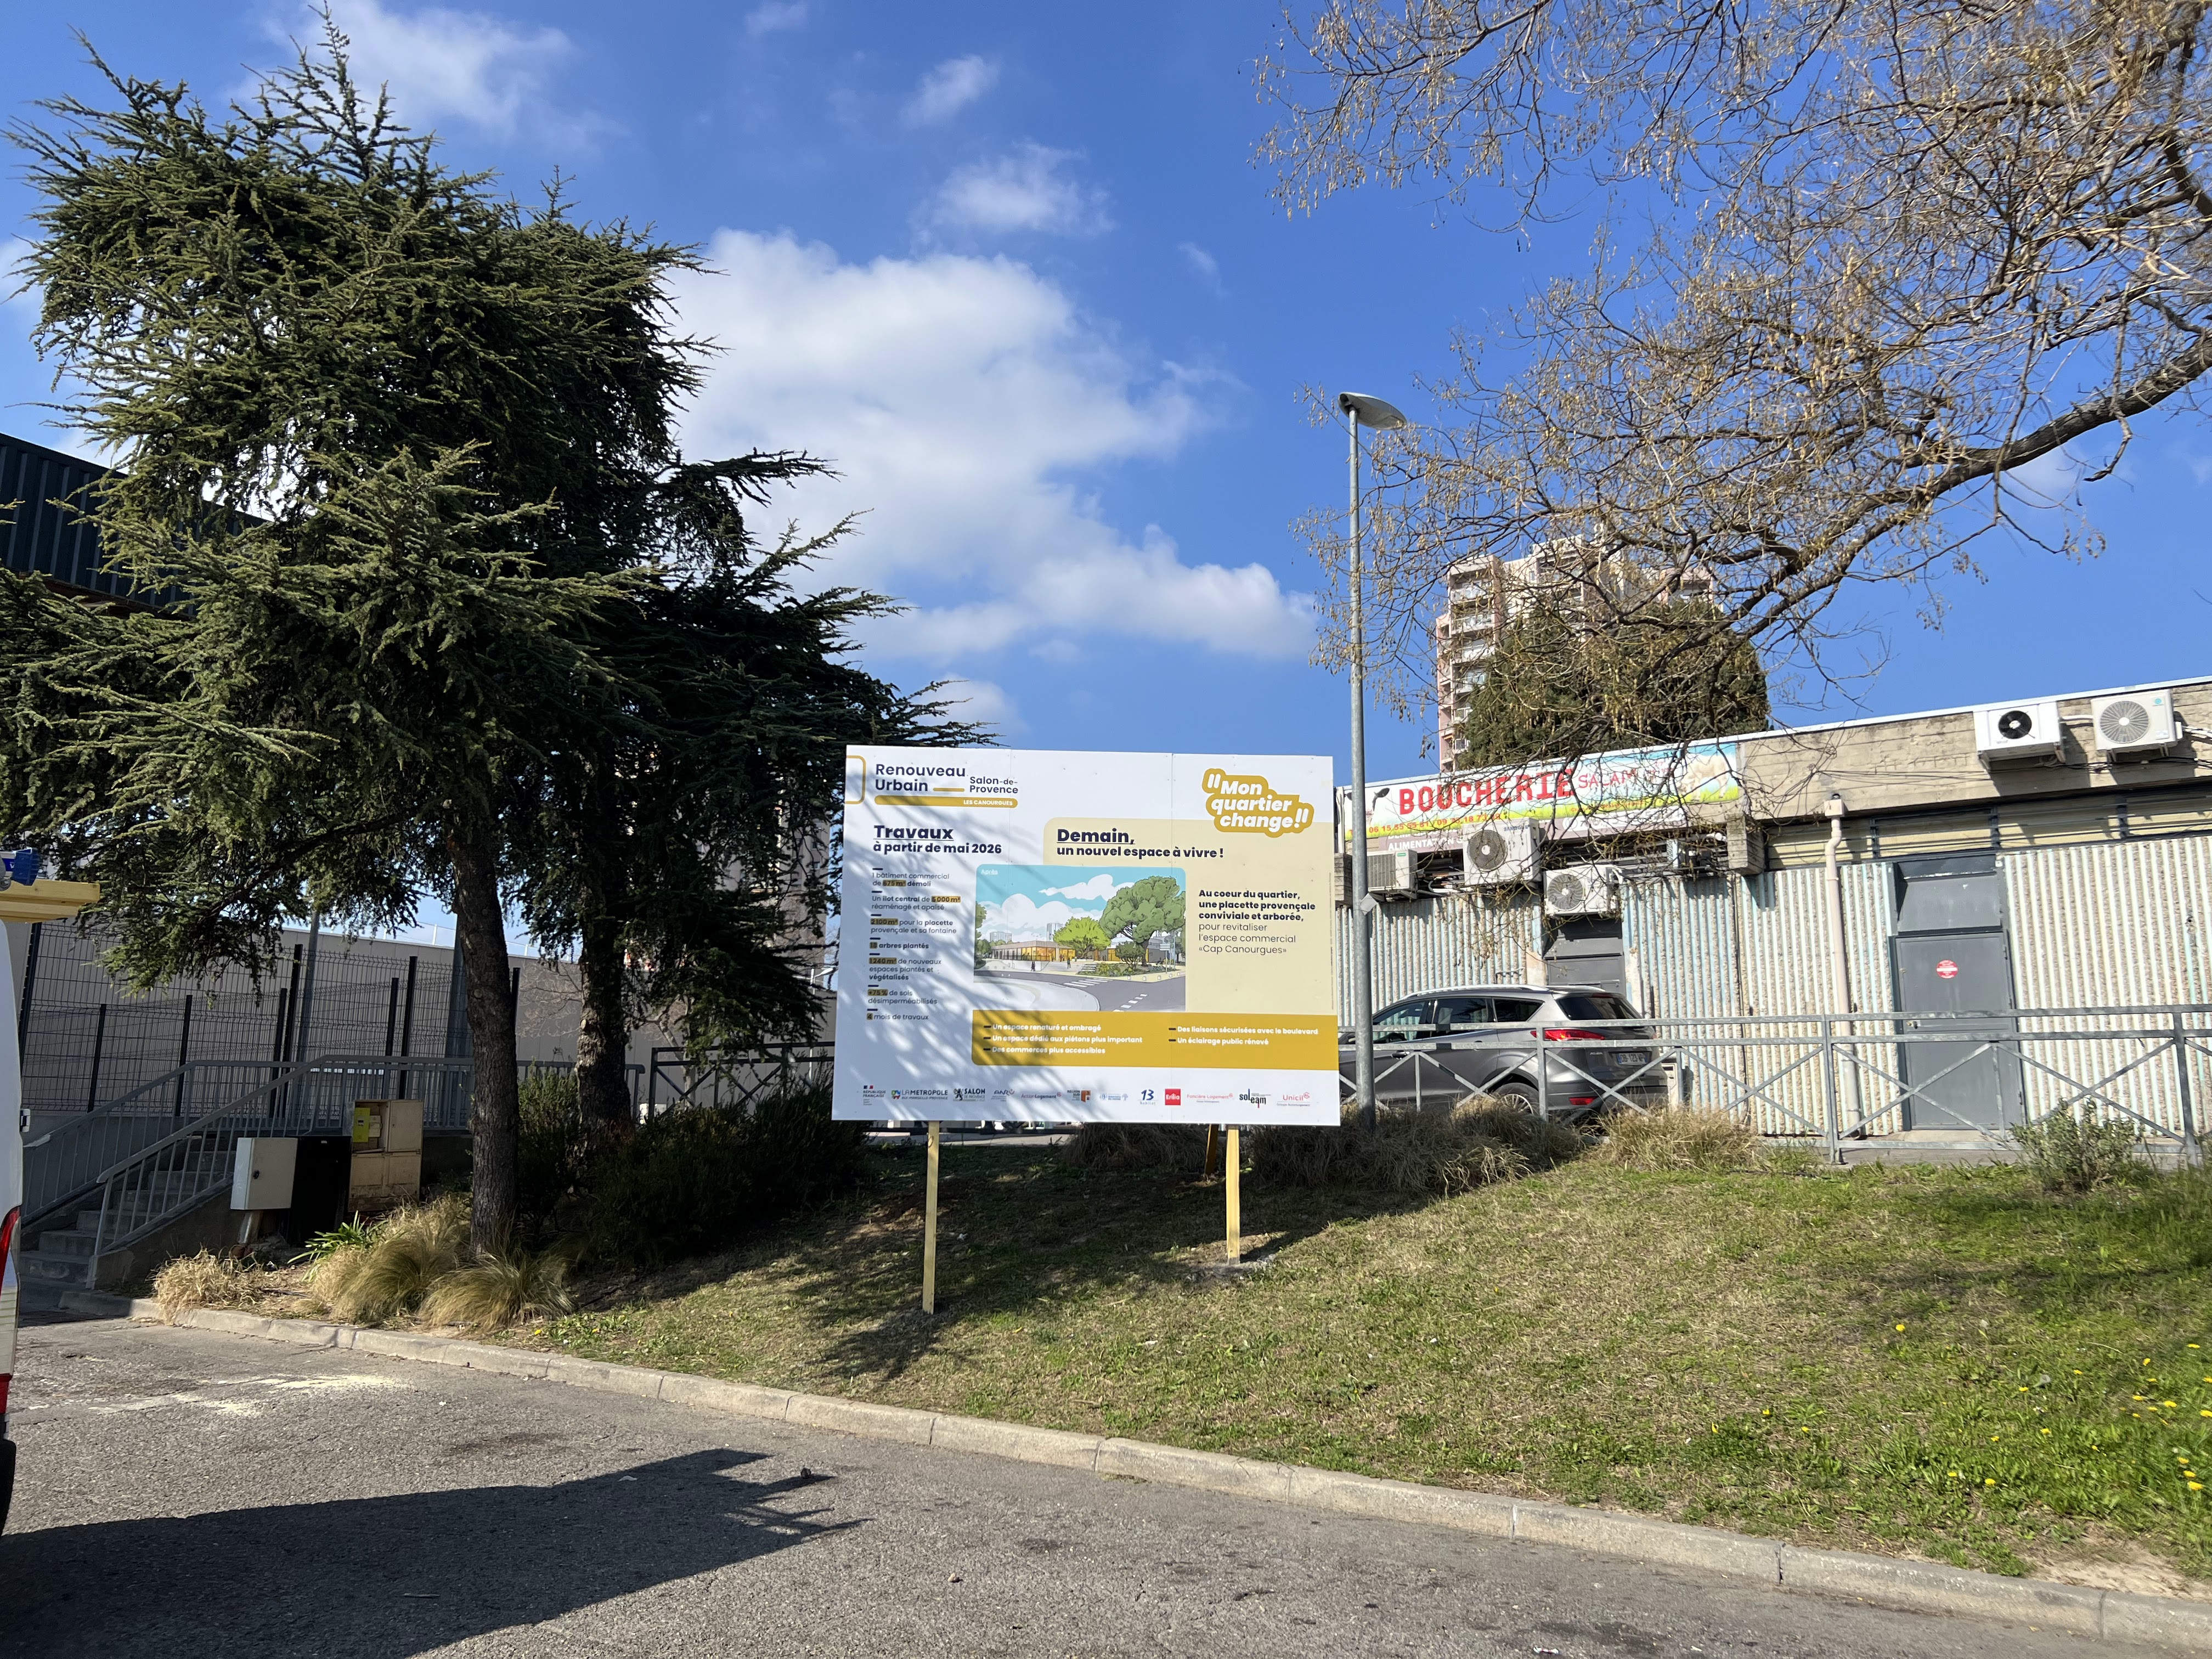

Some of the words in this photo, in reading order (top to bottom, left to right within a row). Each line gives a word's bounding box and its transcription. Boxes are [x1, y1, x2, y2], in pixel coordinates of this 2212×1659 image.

[876, 764, 966, 777] Renouveau
[876, 779, 928, 792] Urbain
[970, 776, 1018, 785] Salon-de-
[970, 785, 1018, 793] Provence
[1400, 768, 1574, 815] BOUCHERIE
[1211, 794, 1292, 815] quartier
[874, 825, 953, 839] Travaux
[1057, 827, 1135, 845] Demain,
[873, 841, 881, 851] à
[884, 842, 922, 855] partir
[926, 843, 941, 853] de
[944, 843, 969, 853] mai
[972, 844, 1002, 854] 2026
[1057, 847, 1074, 855] un
[1076, 846, 1121, 856] nouvel
[1124, 849, 1170, 860] espace
[1172, 847, 1181, 857] à
[1183, 847, 1217, 858] vivre
[1243, 890, 1256, 898] du
[1257, 890, 1300, 900] quartier,
[1218, 900, 1259, 911] placette
[1261, 902, 1316, 912] provençale
[1198, 911, 1250, 919] conviviale
[1262, 912, 1304, 922] arborée,
[1199, 923, 1220, 932] pour
[1223, 923, 1267, 931] revitaliser
[1240, 935, 1296, 943] commercial
[1199, 945, 1222, 955] «Cap
[1225, 945, 1286, 956] Canourgues»
[1107, 1036, 1142, 1045] important
[1188, 1037, 1221, 1046] éclairage
[1141, 1089, 1154, 1101] 13
